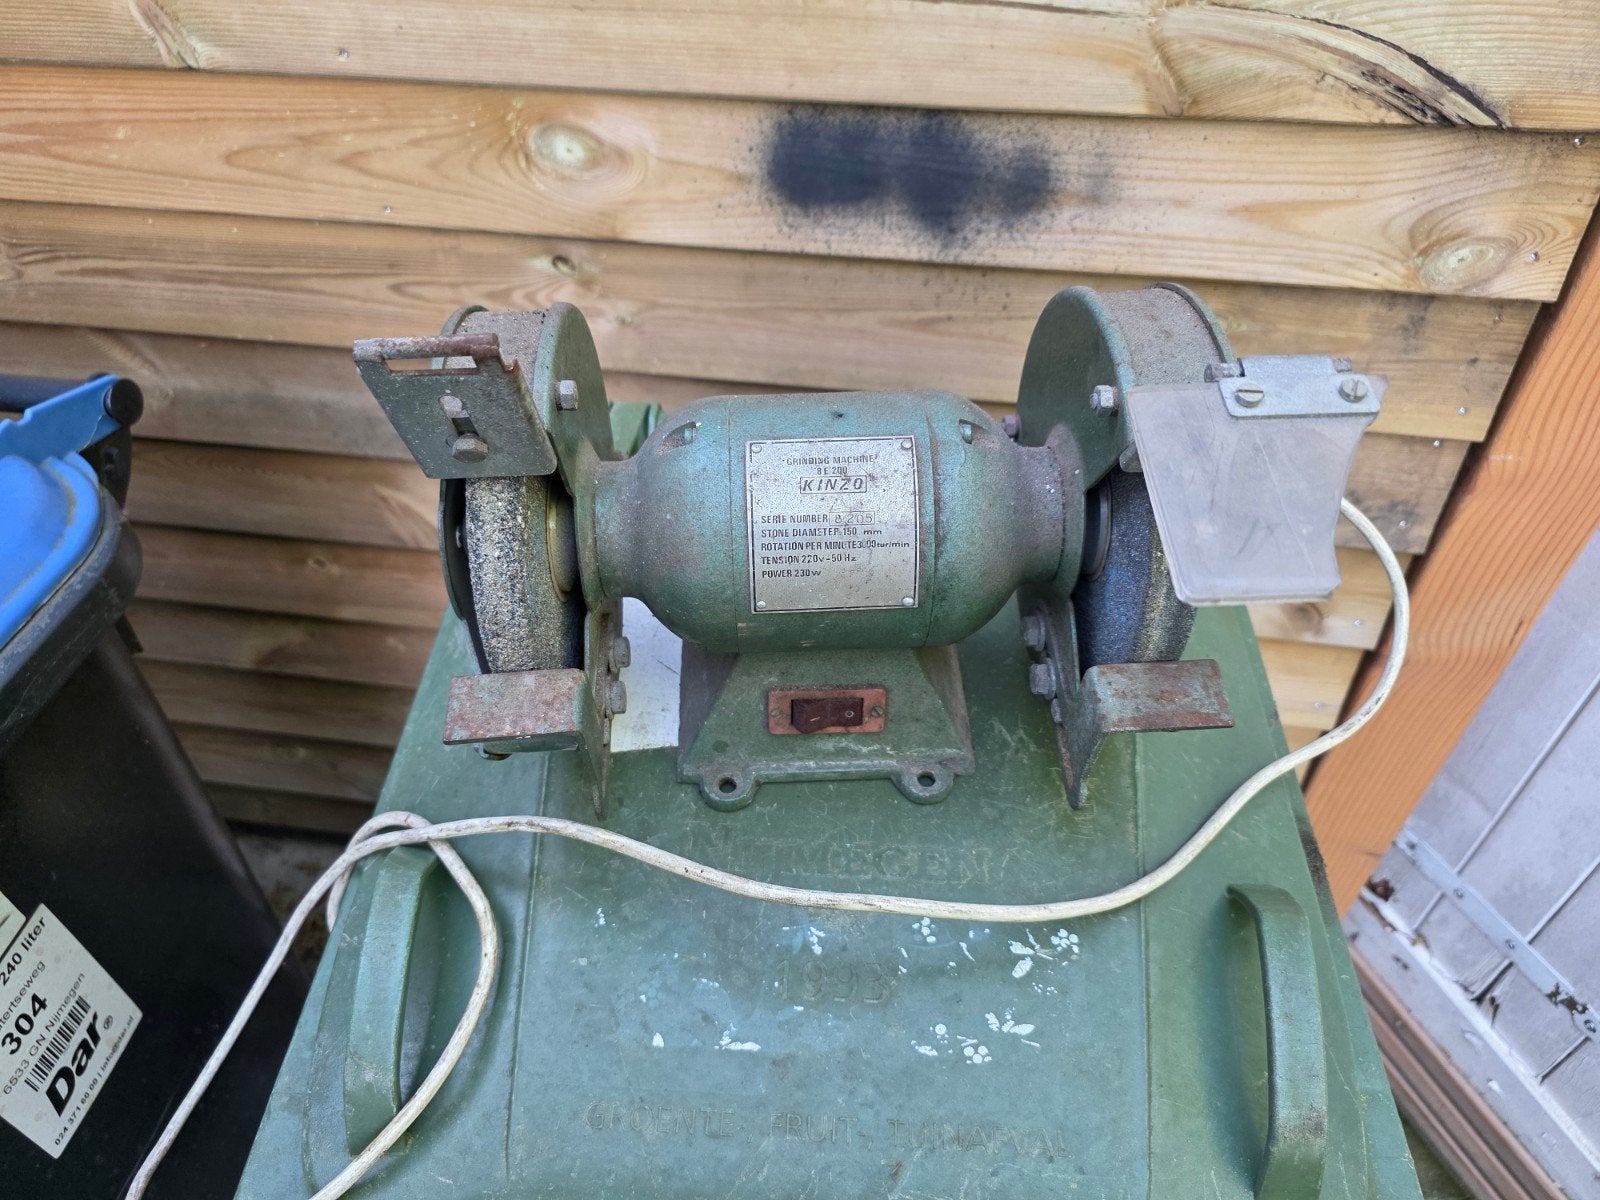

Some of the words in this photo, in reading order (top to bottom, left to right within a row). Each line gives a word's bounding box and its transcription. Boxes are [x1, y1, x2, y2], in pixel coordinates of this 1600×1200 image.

[786, 456, 830, 465] GRINDING
[832, 454, 874, 464] MACHINE
[802, 477, 864, 491] KINZO
[761, 514, 786, 524] SERIE
[789, 513, 828, 524] NUMBER
[761, 528, 789, 538] STONE
[761, 541, 804, 551] ROTATION
[805, 541, 822, 550] PER
[761, 555, 799, 565] TENSION
[761, 569, 793, 579] POWER
[0, 952, 22, 986] 240
[21, 916, 46, 952] liter
[776, 959, 892, 1005] 1993
[0, 960, 46, 1032] tertseweg
[2, 992, 48, 1055] 304
[3, 1059, 29, 1095] 6533
[29, 1034, 46, 1057] GN
[45, 972, 85, 1033] Nijmegen
[54, 1127, 69, 1146] 024
[67, 1107, 81, 1125] 371
[81, 1092, 90, 1106] 60
[89, 1078, 98, 1091] 00
